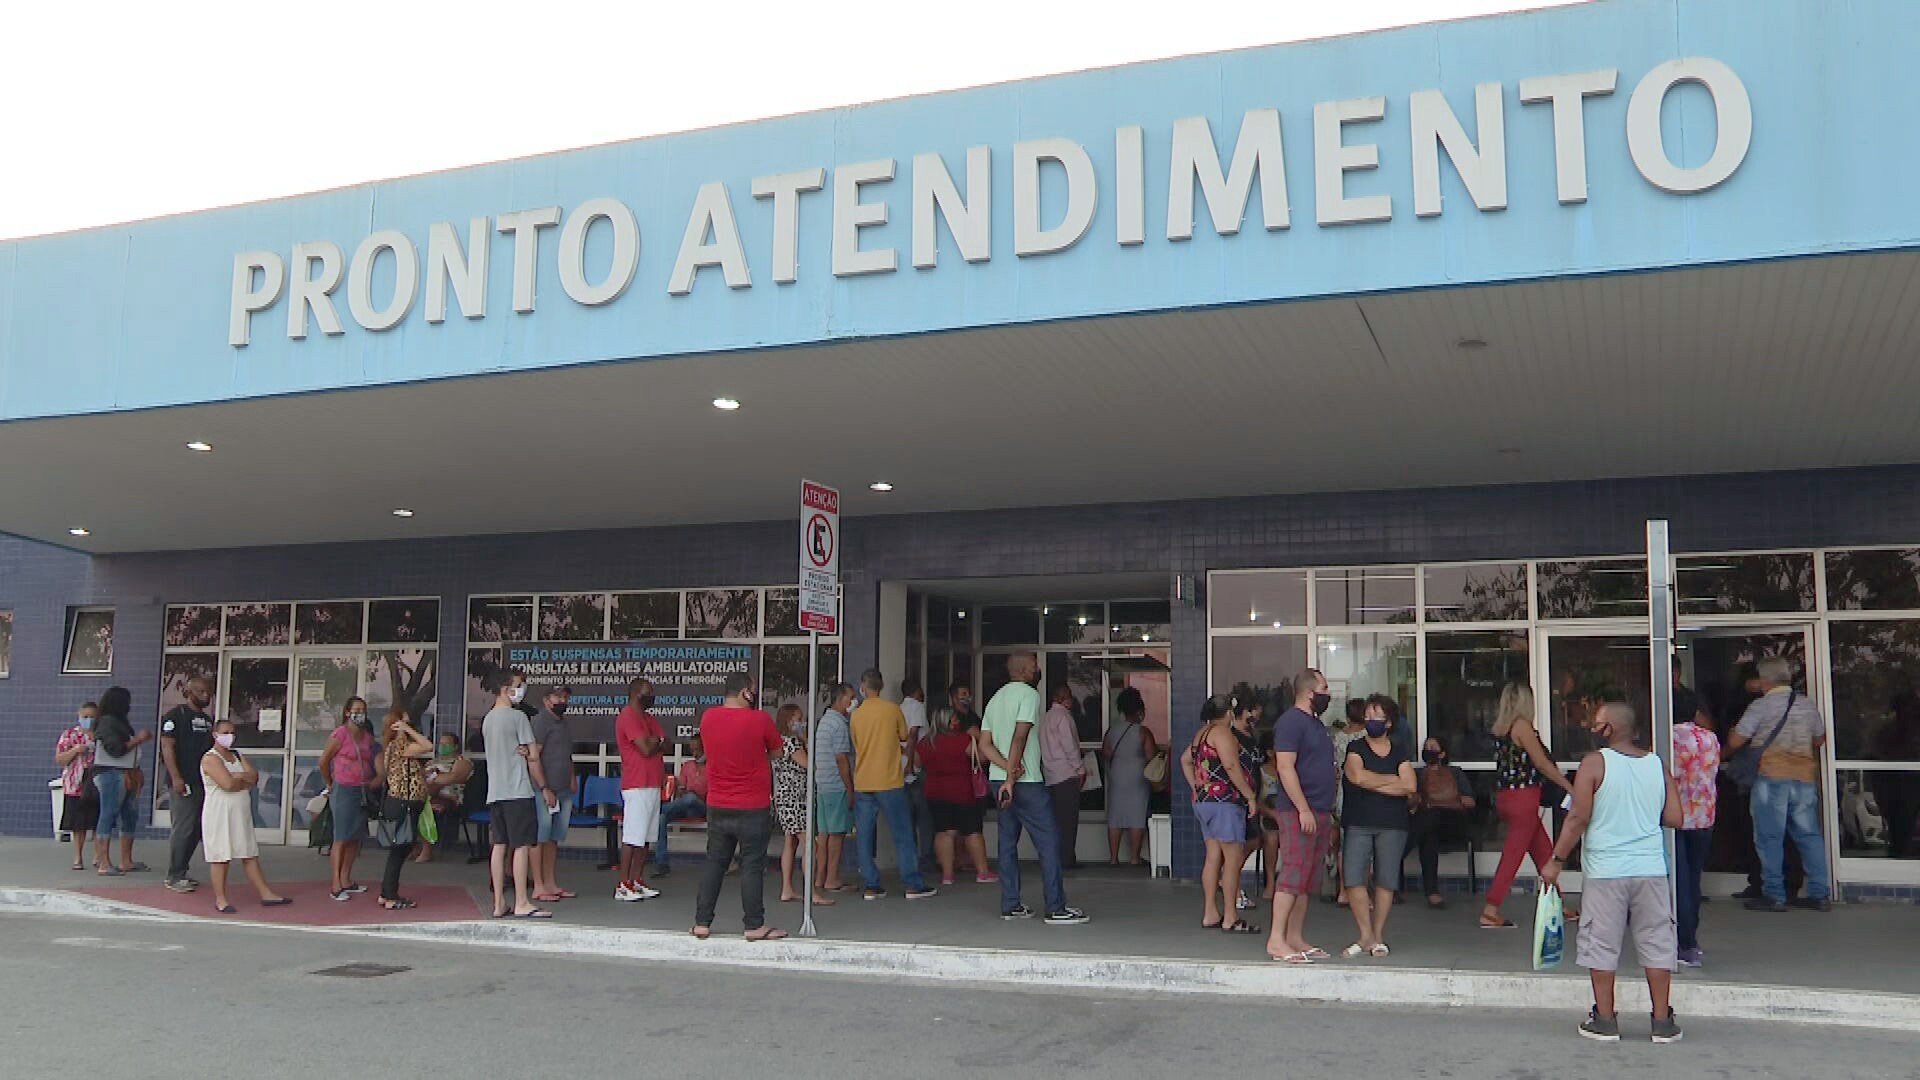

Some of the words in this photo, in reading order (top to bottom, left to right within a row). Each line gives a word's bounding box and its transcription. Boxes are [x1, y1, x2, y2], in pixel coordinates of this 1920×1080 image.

[229, 198, 640, 347] PRONTO
[667, 55, 1753, 296] ATENDIMENTO
[804, 487, 837, 509] ATENÇÃO
[510, 647, 549, 660] ESTÃO
[551, 648, 621, 660] SUSPENSAS
[625, 647, 752, 659] TEMPORARIAMENTE
[580, 662, 588, 673] E
[591, 662, 641, 673] EXAMES
[643, 661, 748, 673] AMBULATORIAIS
[565, 676, 602, 684] SOMENTE
[604, 675, 625, 684] PARA
[675, 675, 681, 684] E
[682, 674, 727, 685] EMERGÊNC
[568, 695, 612, 704] REFEITURA
[614, 695, 629, 704] EST
[680, 695, 698, 704] SUA
[585, 707, 620, 715] CONTRA
